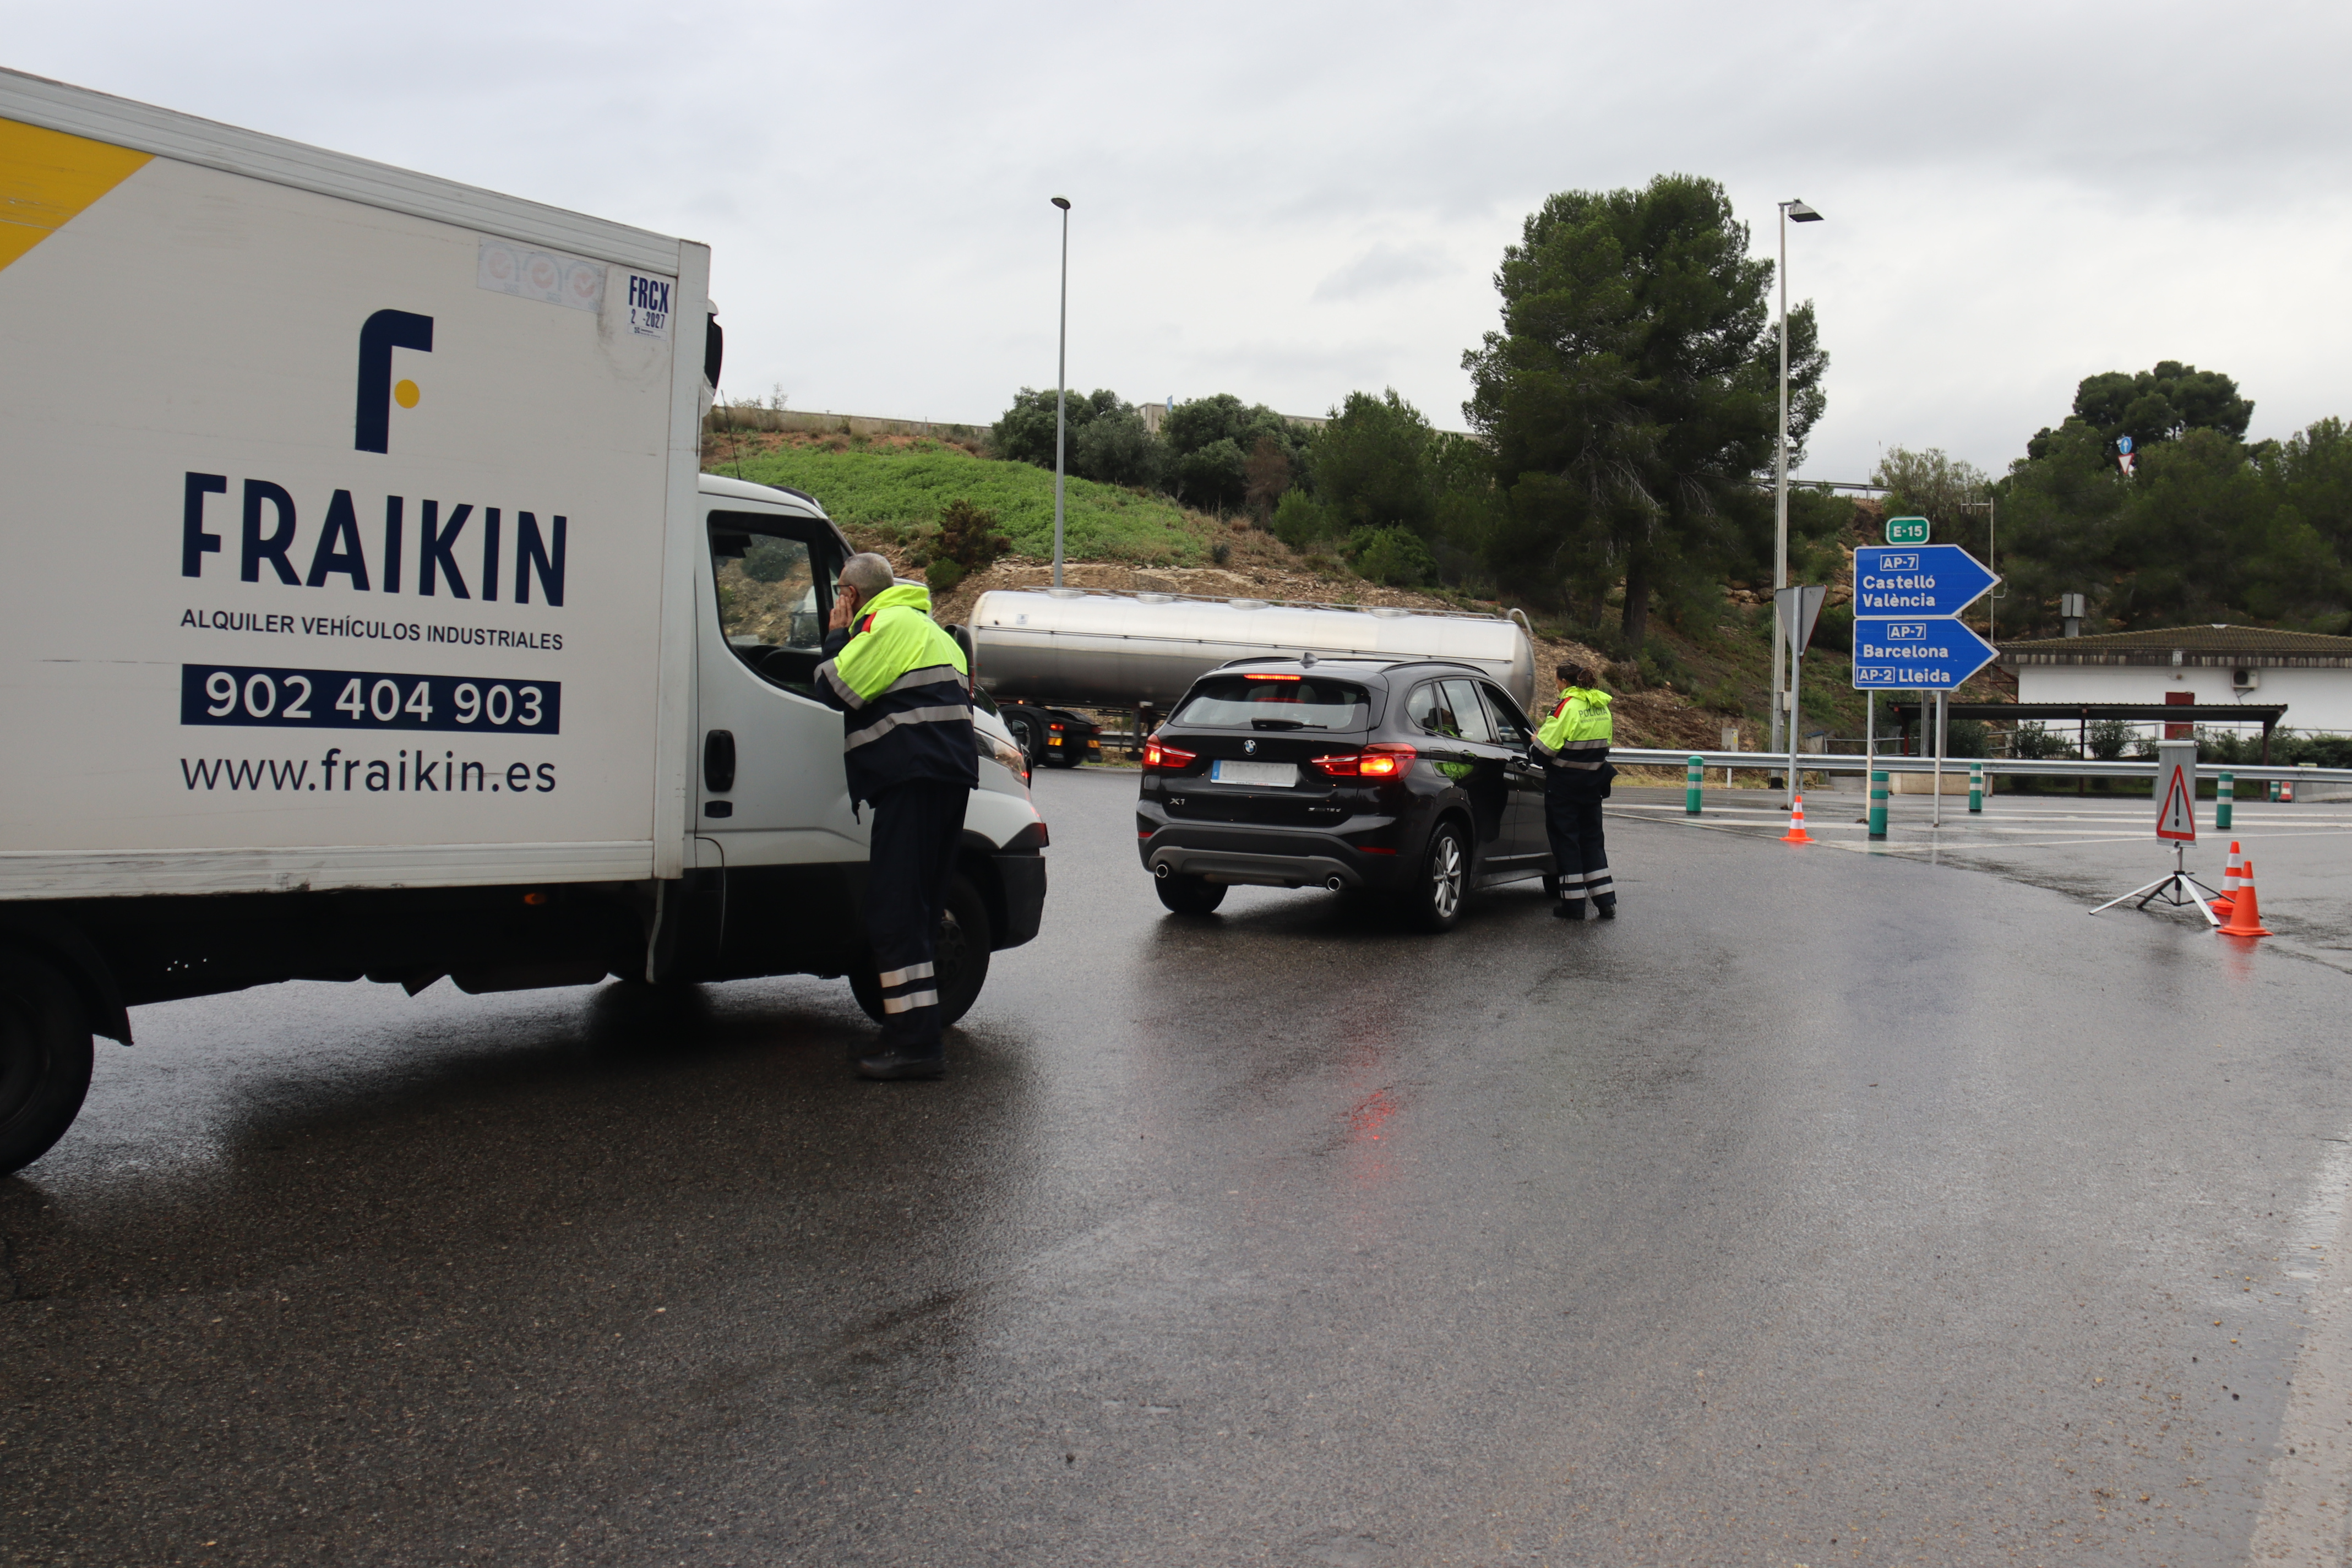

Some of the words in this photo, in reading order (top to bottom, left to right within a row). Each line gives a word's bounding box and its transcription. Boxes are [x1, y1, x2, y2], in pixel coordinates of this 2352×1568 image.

[629, 275, 669, 314] FRCX
[182, 471, 567, 607] FRAIKIN
[1893, 526, 1923, 537] E-15
[1883, 557, 1915, 569] AP-7
[1863, 575, 1936, 590] Castelló
[1863, 592, 1936, 607] València
[181, 609, 295, 634] ALQUILER
[301, 615, 421, 641] VEHÍCULOS
[427, 625, 563, 651] INDUSTRIALES
[1890, 626, 1923, 638] AP-7
[1863, 644, 1949, 658] Barcelona
[1859, 669, 1892, 680] AP-2
[1899, 668, 1951, 683] Lleida
[205, 672, 312, 718] 902
[335, 678, 433, 722] 404
[454, 683, 543, 726] 903
[181, 748, 556, 793] www.fraikin.es
